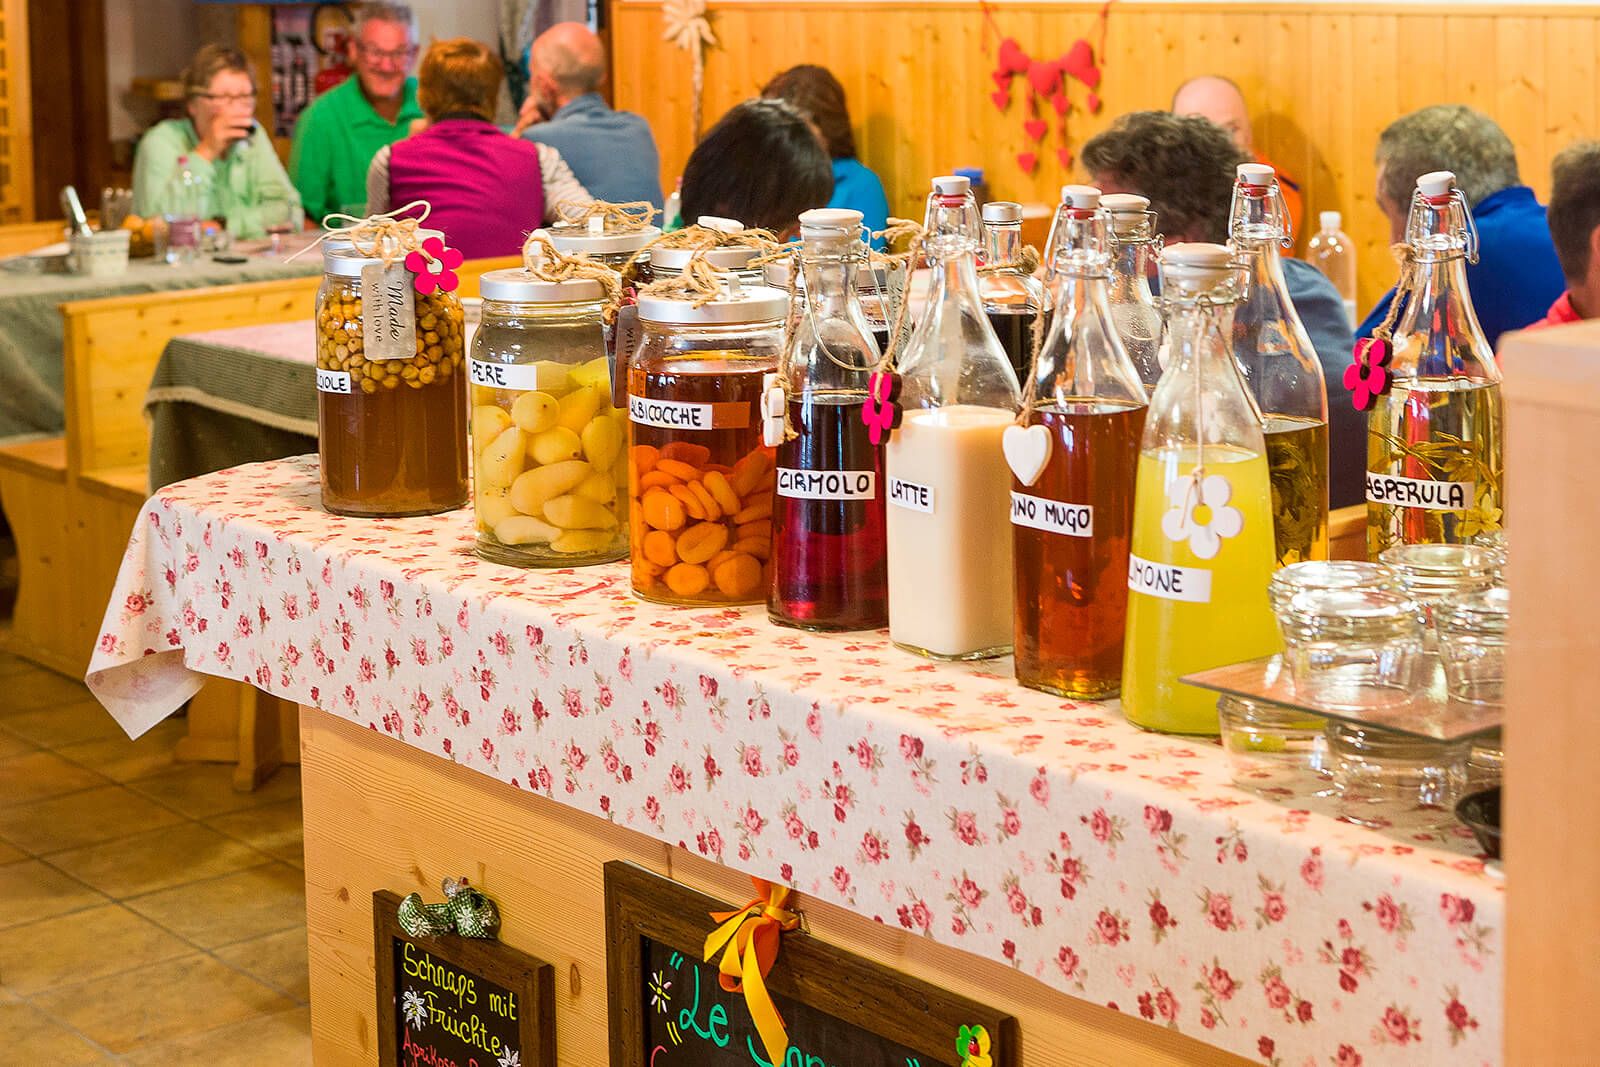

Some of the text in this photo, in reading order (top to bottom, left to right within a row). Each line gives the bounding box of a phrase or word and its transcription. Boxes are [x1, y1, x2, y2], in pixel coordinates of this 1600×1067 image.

[371, 283, 385, 342] with love
[387, 281, 406, 341] Made
[472, 361, 506, 386] PERE
[779, 471, 870, 495] CIRMOLO
[891, 479, 928, 507] LATTE
[1366, 477, 1464, 508] ASPERULA
[1012, 498, 1090, 533] INO MUGO
[403, 942, 517, 1020] Schnaps mit
[424, 991, 502, 1056] Früchte
